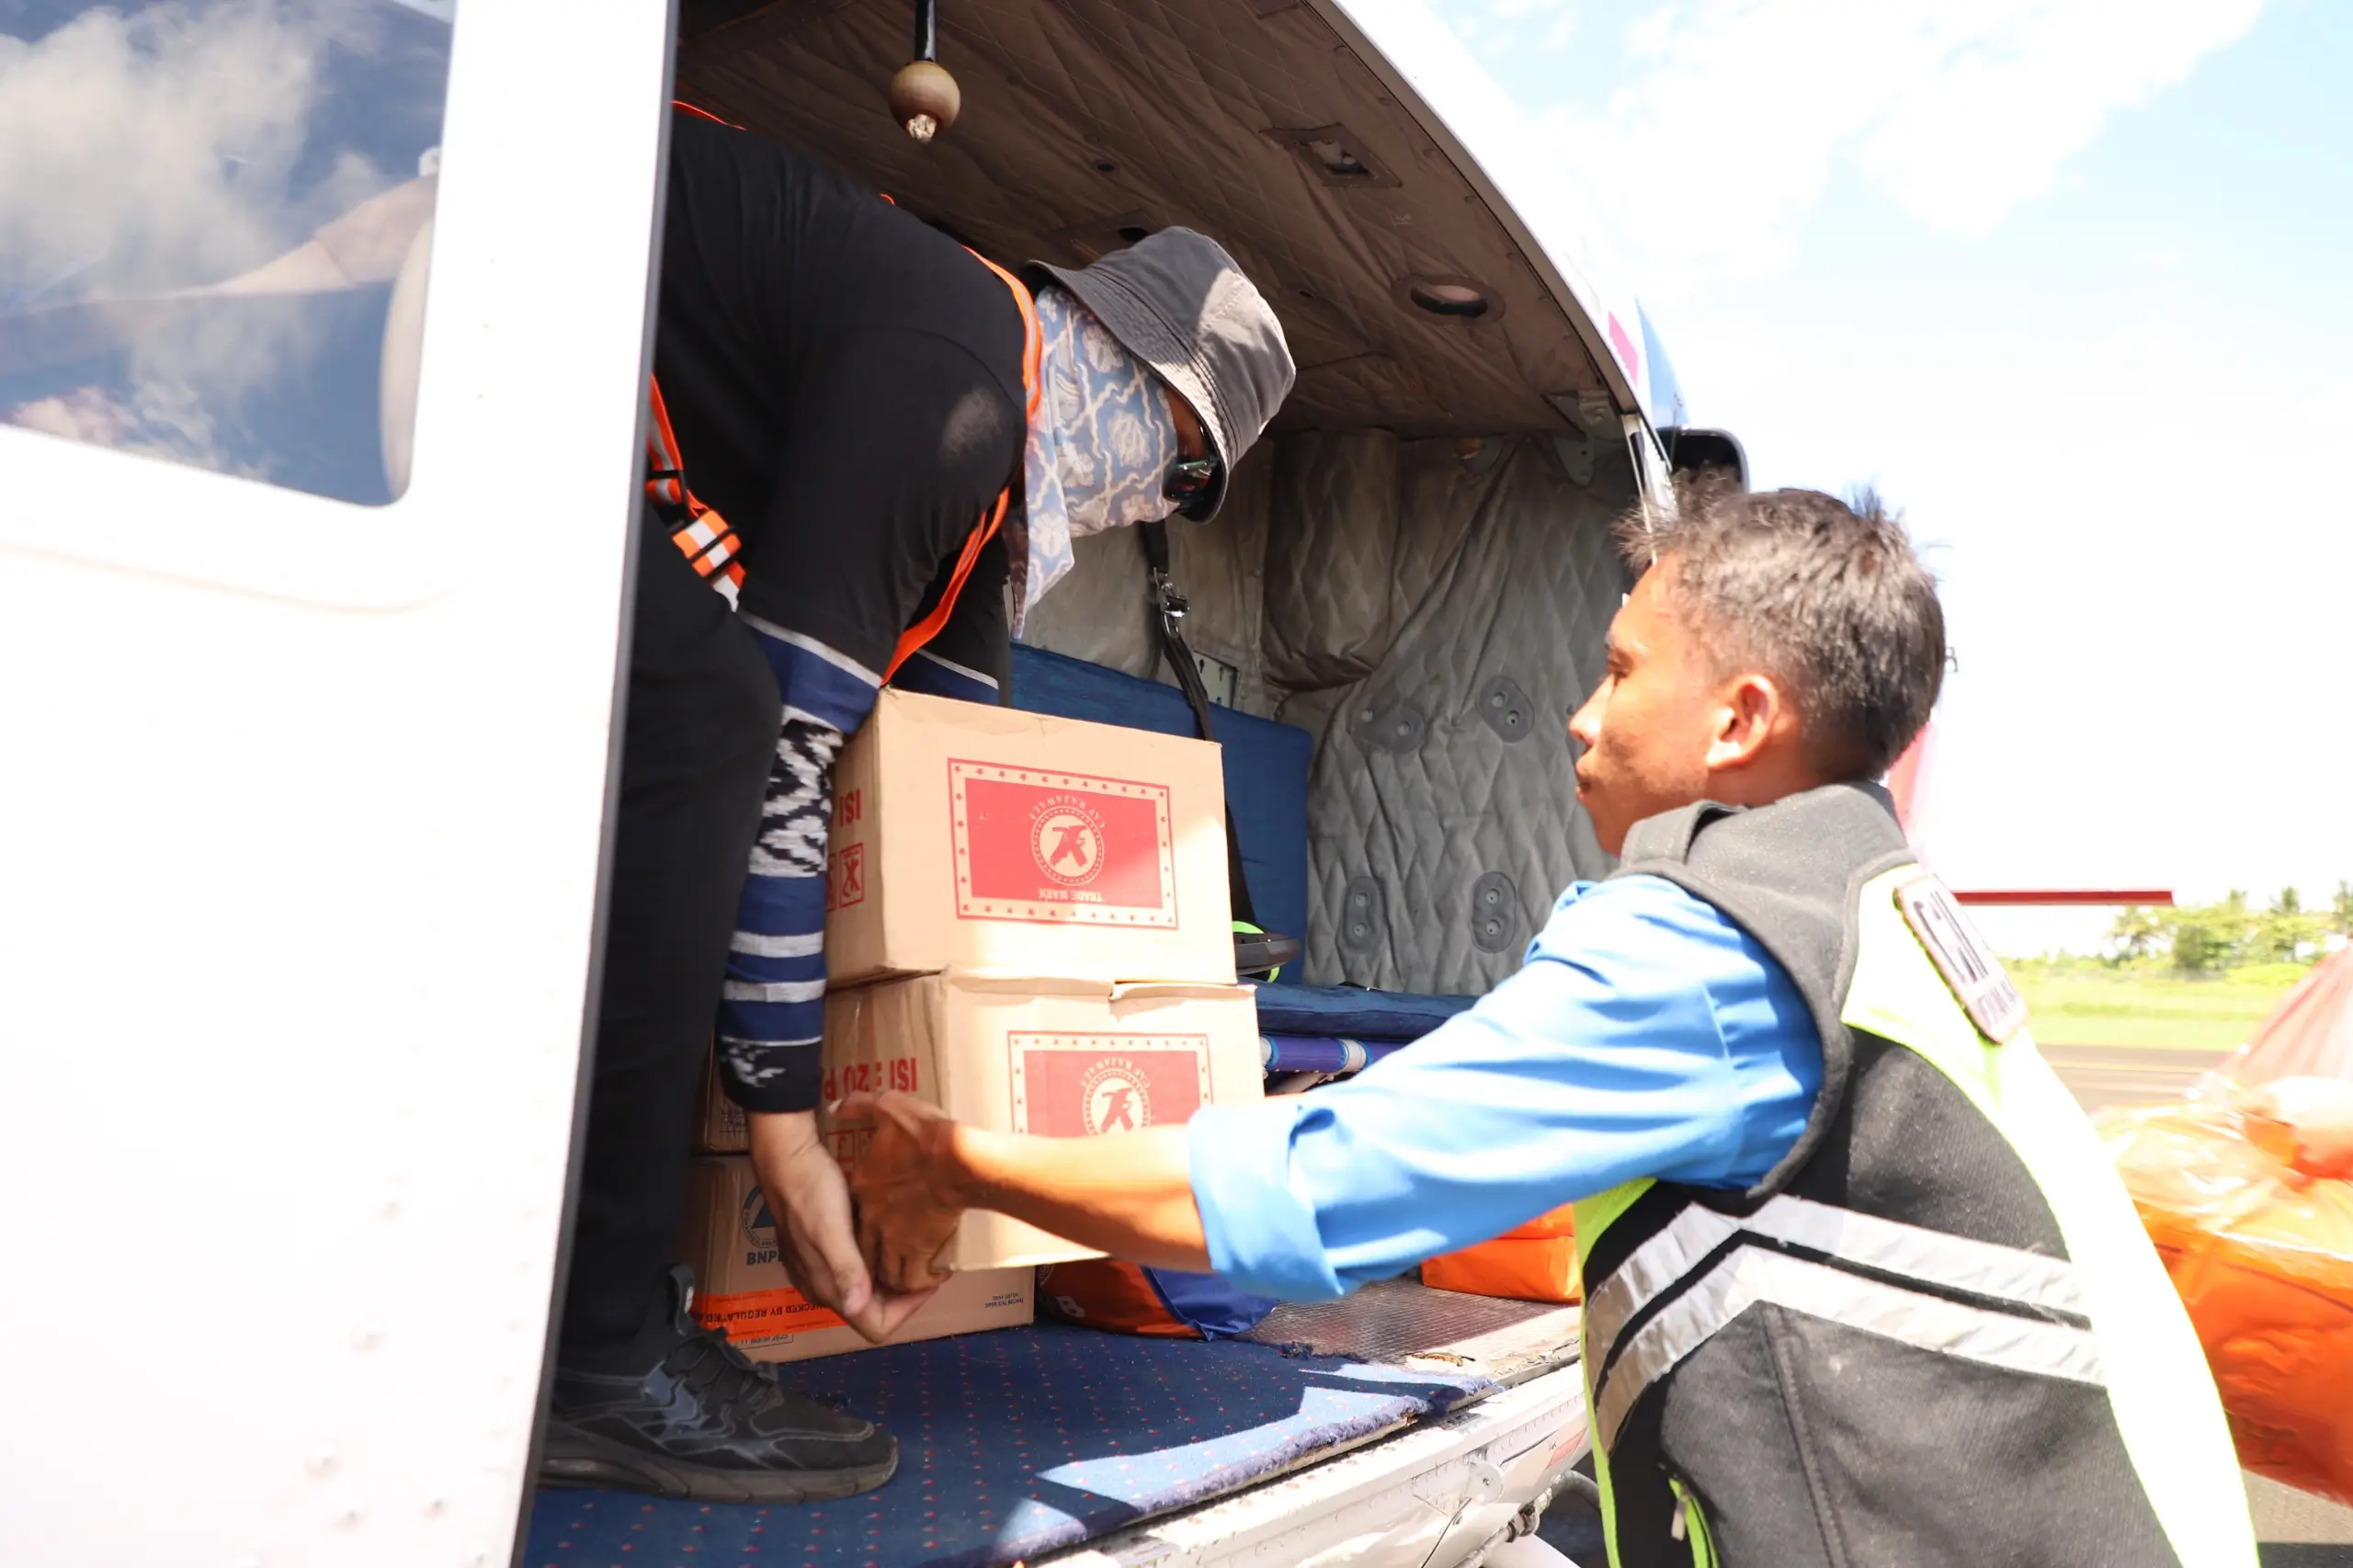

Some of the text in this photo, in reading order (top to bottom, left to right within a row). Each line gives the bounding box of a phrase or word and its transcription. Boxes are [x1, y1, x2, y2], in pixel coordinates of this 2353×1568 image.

[839, 788, 861, 827] ISI
[1029, 795, 1086, 820] RAJAWALI
[1038, 888, 1103, 902] TRADE MARK
[824, 1067, 837, 1101] P
[843, 1063, 870, 1093] 20
[889, 1057, 917, 1095] ISI
[746, 1250, 780, 1265] BNP
[706, 1309, 767, 1323] REGULATED
[770, 1307, 783, 1316] BY
